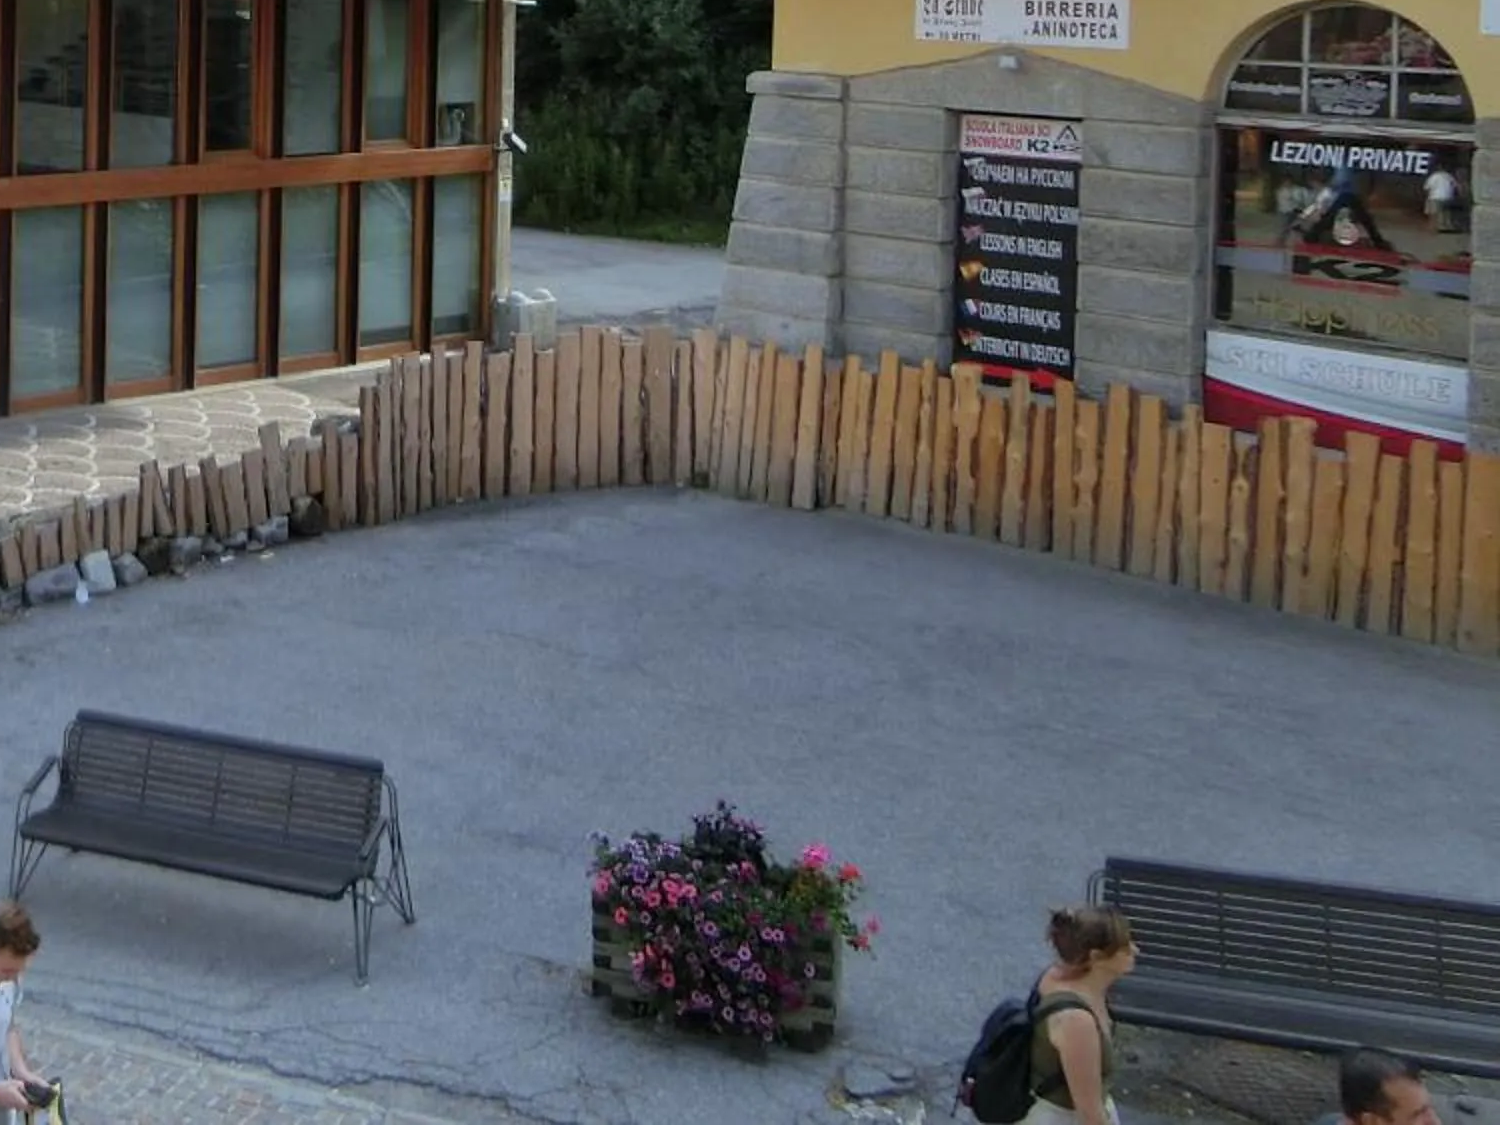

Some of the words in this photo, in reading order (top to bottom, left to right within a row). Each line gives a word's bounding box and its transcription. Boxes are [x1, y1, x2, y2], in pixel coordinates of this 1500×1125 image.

[1024, 0, 1119, 19] BIRRERIA
[1024, 21, 1119, 39] ANINOTECA
[1027, 138, 1051, 153] K2
[1270, 140, 1344, 168] LEZIONI
[1347, 146, 1431, 174] PRIVATE
[980, 233, 1017, 254] LESSONS
[1018, 236, 1027, 255] IN
[1028, 237, 1062, 259] ENGLISH
[980, 266, 1010, 288] CLASES
[1011, 270, 1022, 290] EN
[1291, 254, 1408, 285] K2
[980, 302, 1007, 322] COURS
[1008, 304, 1019, 324] EN
[1030, 343, 1072, 366] DEUTSCH
[1225, 344, 1290, 377] SKI
[1298, 356, 1452, 405] SCHULE
